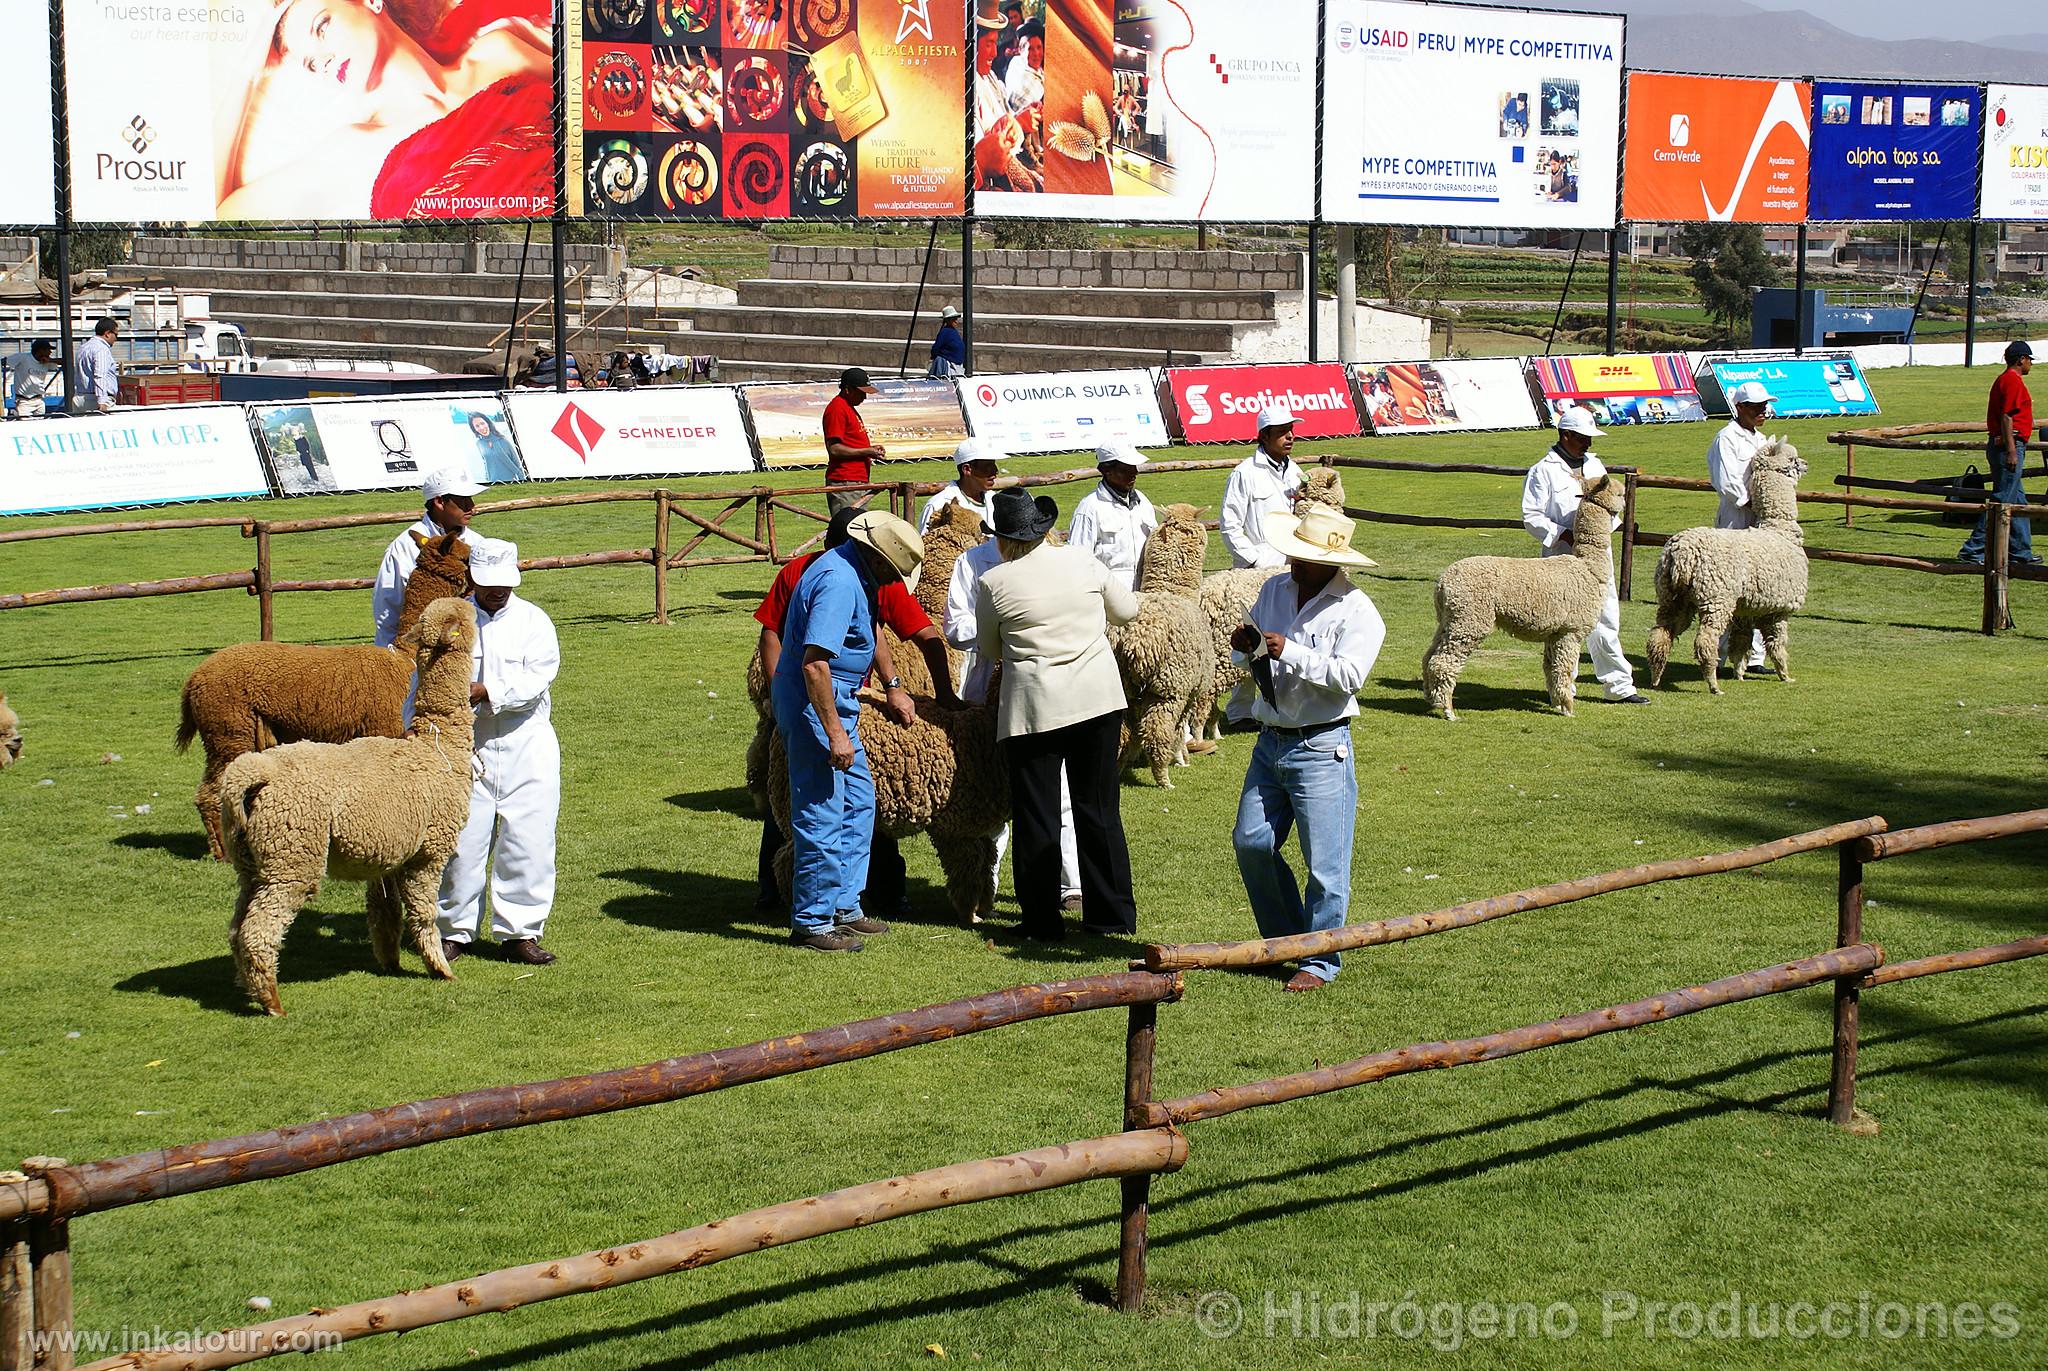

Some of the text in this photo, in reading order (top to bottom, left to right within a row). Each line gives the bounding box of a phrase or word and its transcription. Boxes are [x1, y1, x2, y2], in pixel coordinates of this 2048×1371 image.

[105, 6, 245, 24] nuestra esencia
[918, 45, 958, 57] FIESTA
[1359, 27, 1614, 61] USAID PERU MYPE COMPETITIVA
[900, 58, 928, 66] 2007
[1228, 58, 1301, 73] GRUPO INCA
[1988, 93, 2008, 115] COLOR
[571, 75, 583, 177] AREQUIPA
[1993, 117, 2015, 142] CENTER
[874, 156, 921, 169] FUTURE
[1653, 148, 1701, 163] Cerro Verde
[1846, 145, 1888, 169] alpha
[1892, 146, 1919, 169] tops
[96, 153, 187, 181] Prosur
[1362, 156, 1498, 178] MYPE COMPETITIVA
[910, 184, 938, 193] FUTURO
[415, 196, 550, 214] www.prosur.com.pe
[1599, 366, 1633, 376] DHL
[1003, 386, 1077, 403] QUIMICA
[1082, 384, 1131, 398] SUIZA
[1221, 387, 1349, 415] Scotiabank
[151, 423, 220, 448] CORP.
[618, 426, 717, 439] SCHNEIDER
